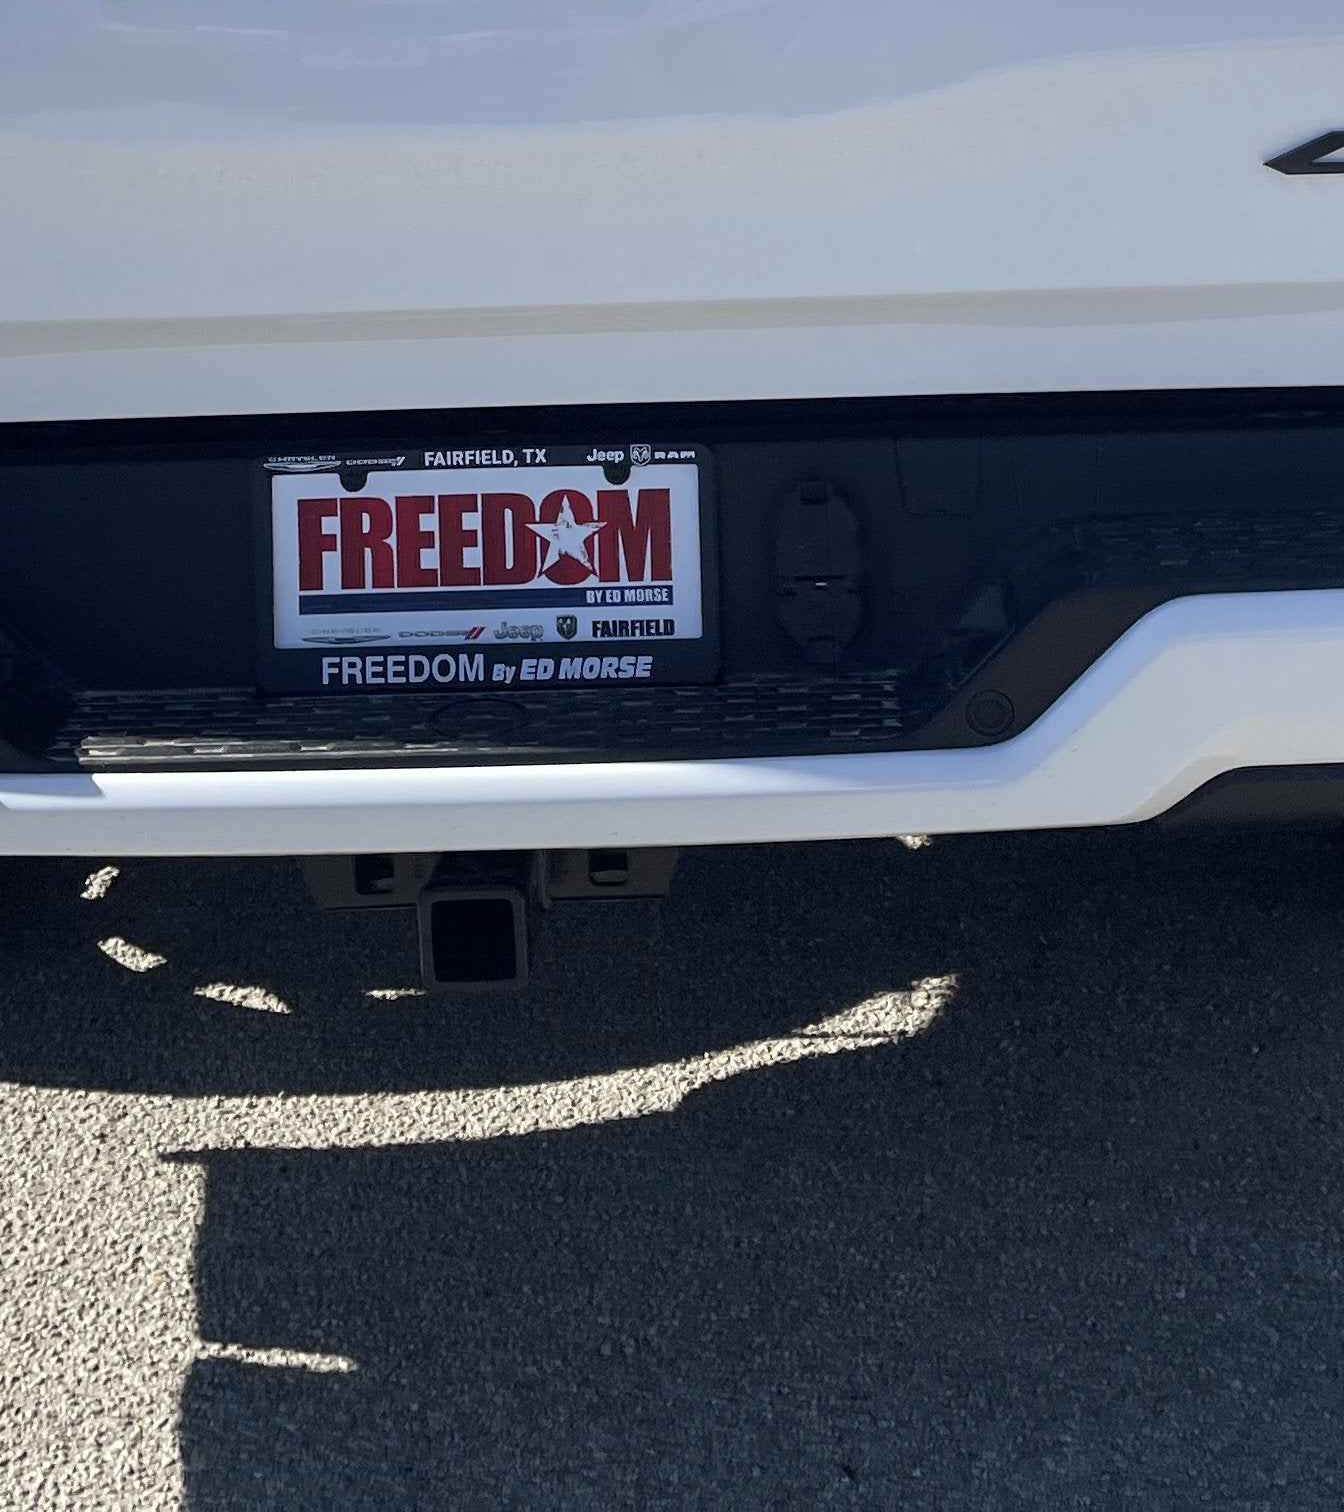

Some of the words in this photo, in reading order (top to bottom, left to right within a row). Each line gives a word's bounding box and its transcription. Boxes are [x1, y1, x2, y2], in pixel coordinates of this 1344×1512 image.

[424, 449, 518, 467] FAIRFIELD,
[522, 448, 547, 464] TX
[586, 448, 625, 463] Jeep
[297, 488, 673, 591] FREEDOM
[586, 590, 603, 604] BY
[606, 589, 622, 603] ED
[624, 587, 669, 602] MORSE
[493, 621, 544, 641] Jeep
[592, 619, 675, 637] FAIRFIELD
[322, 653, 485, 684] FREEDOM
[492, 663, 516, 684] By
[520, 658, 554, 680] ED
[558, 656, 653, 679] MORSE
